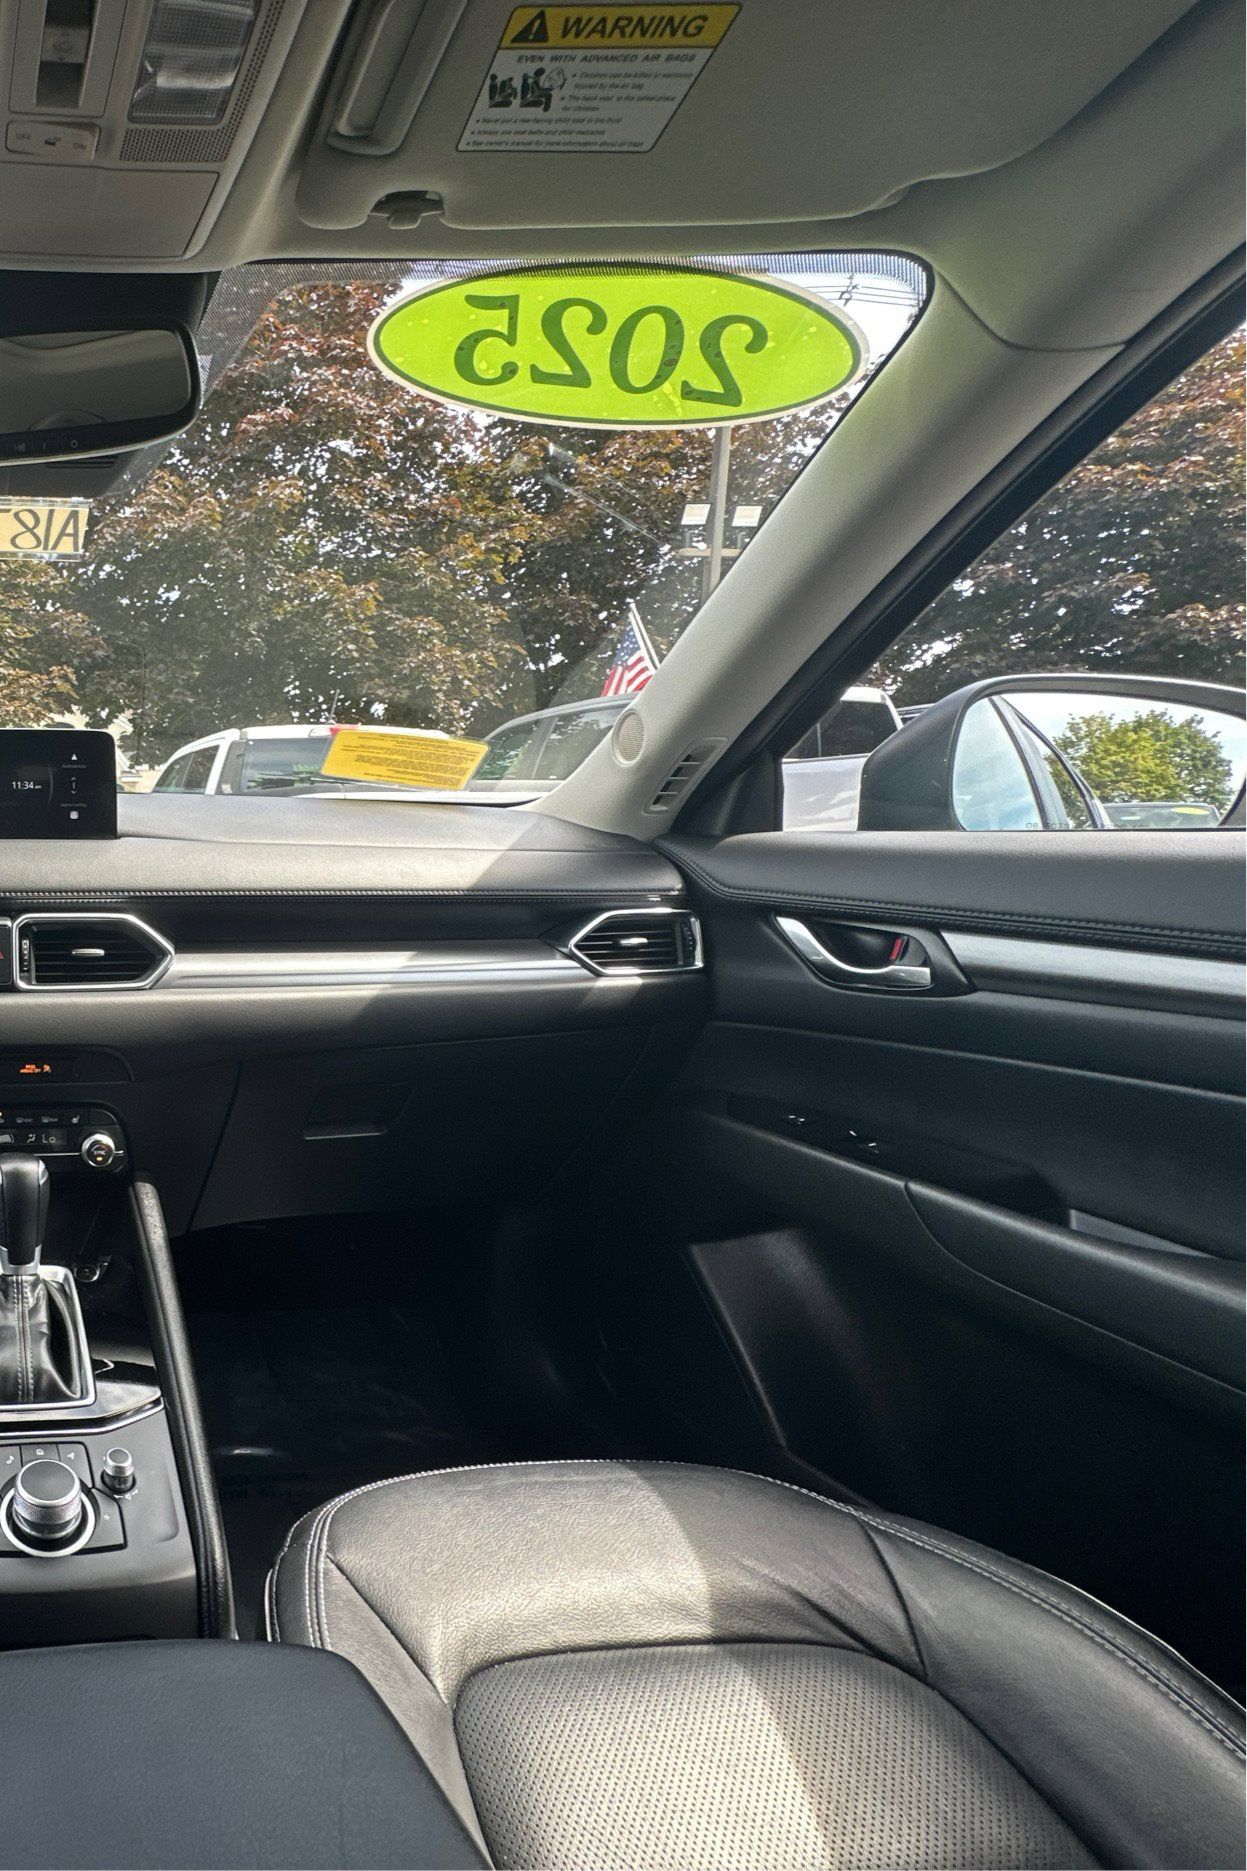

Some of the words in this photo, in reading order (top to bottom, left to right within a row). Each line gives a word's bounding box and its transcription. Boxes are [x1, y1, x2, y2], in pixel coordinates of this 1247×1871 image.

[560, 14, 708, 39] WARNING
[517, 54, 545, 63] EVEN
[549, 54, 577, 63] WITH
[580, 54, 638, 63] ADVANCED
[641, 54, 662, 63] AIR
[664, 54, 697, 63] BAGS
[73, 142, 86, 150] ON
[12, 781, 34, 790] 11:34
[42, 1134, 57, 1144] Lo
